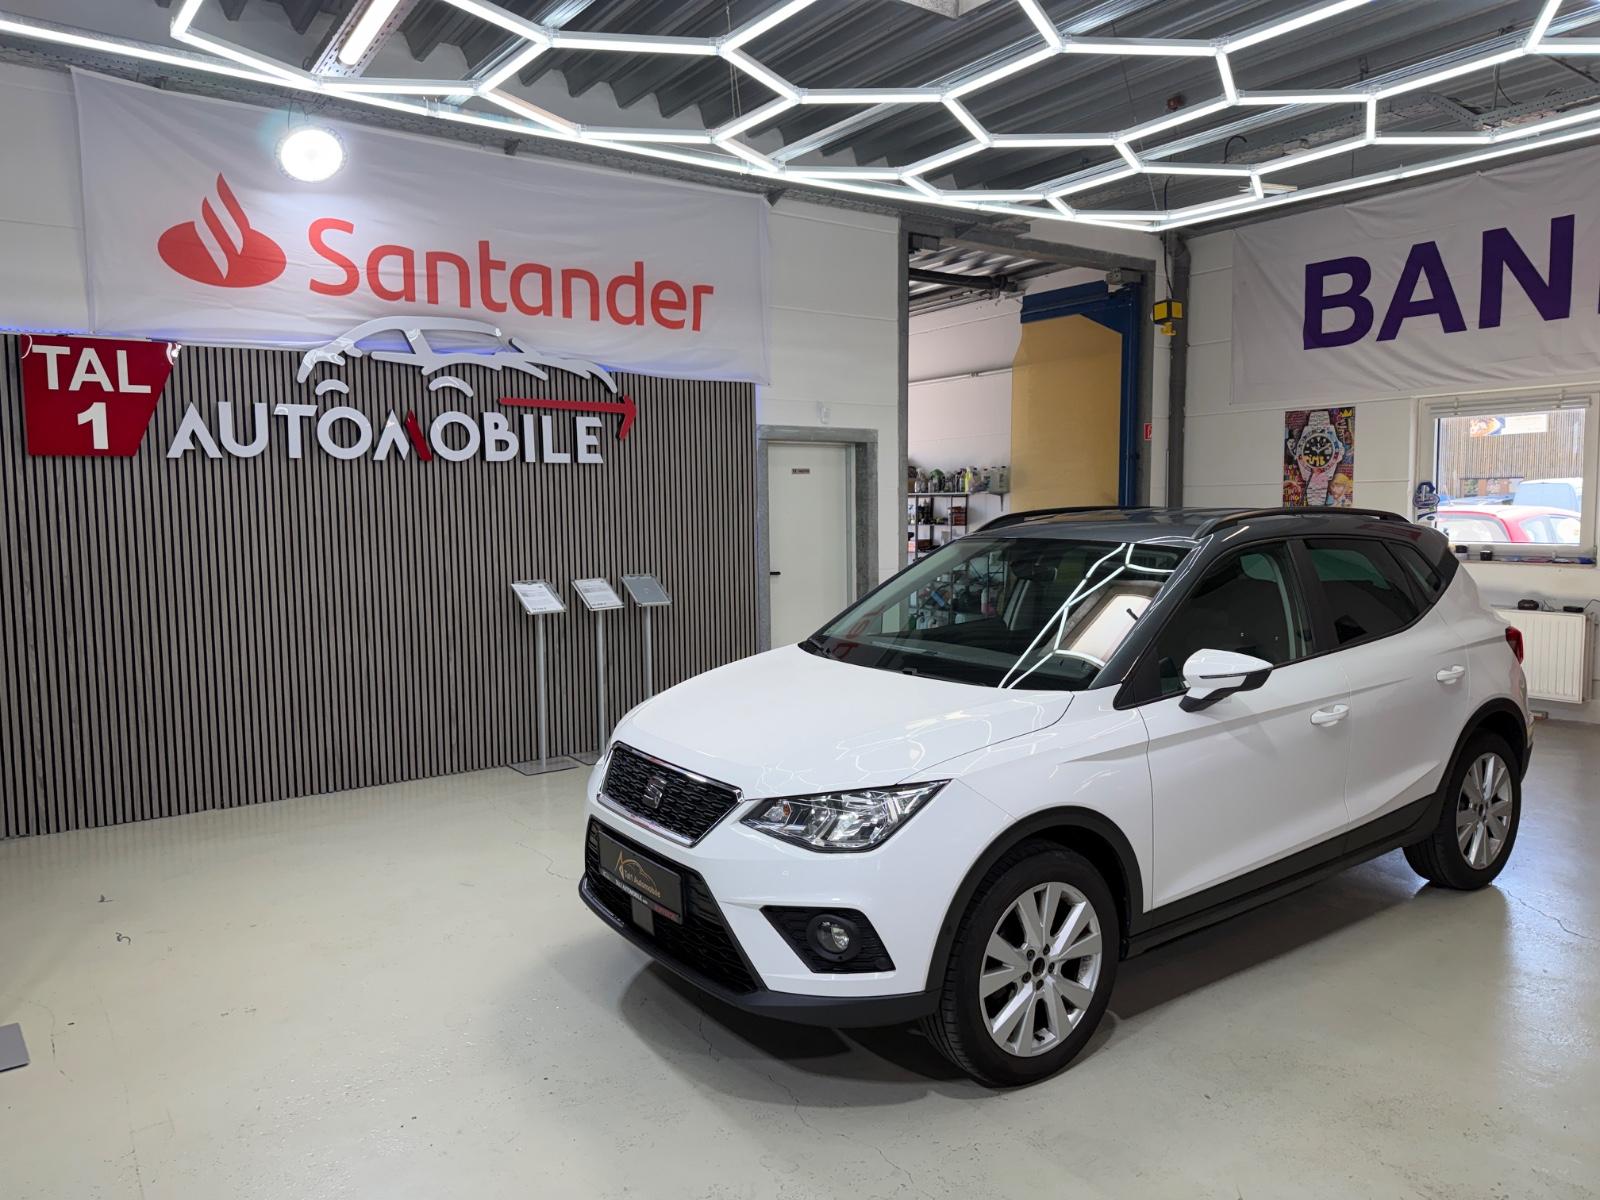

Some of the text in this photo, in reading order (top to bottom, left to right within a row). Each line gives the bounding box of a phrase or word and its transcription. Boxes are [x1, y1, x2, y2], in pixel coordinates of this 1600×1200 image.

[308, 217, 714, 332] Santander
[1303, 214, 1600, 350] BAN
[32, 344, 151, 394] TAL
[77, 402, 109, 450] 1
[166, 401, 604, 464] AUTOMOBILE
